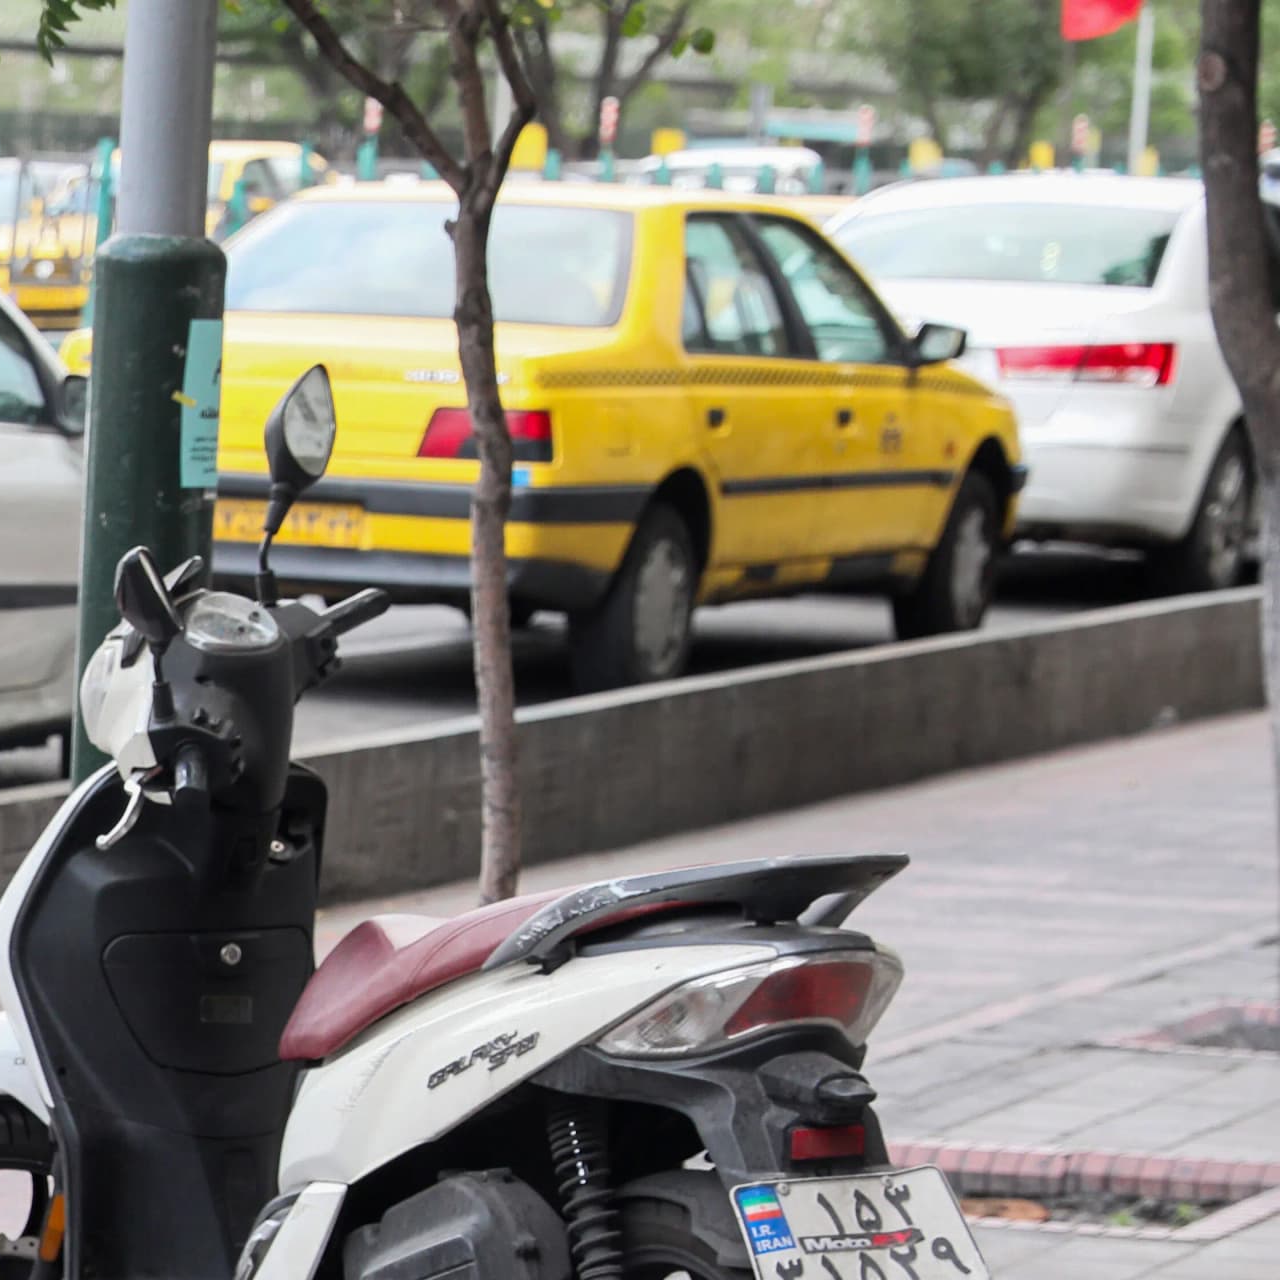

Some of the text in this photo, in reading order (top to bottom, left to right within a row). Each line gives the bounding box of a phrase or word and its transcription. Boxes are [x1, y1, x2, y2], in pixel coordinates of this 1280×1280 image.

[816, 1183, 914, 1234] ۱۵۳
[751, 1223, 776, 1238] I.R.
[756, 1236, 794, 1254] IRAN
